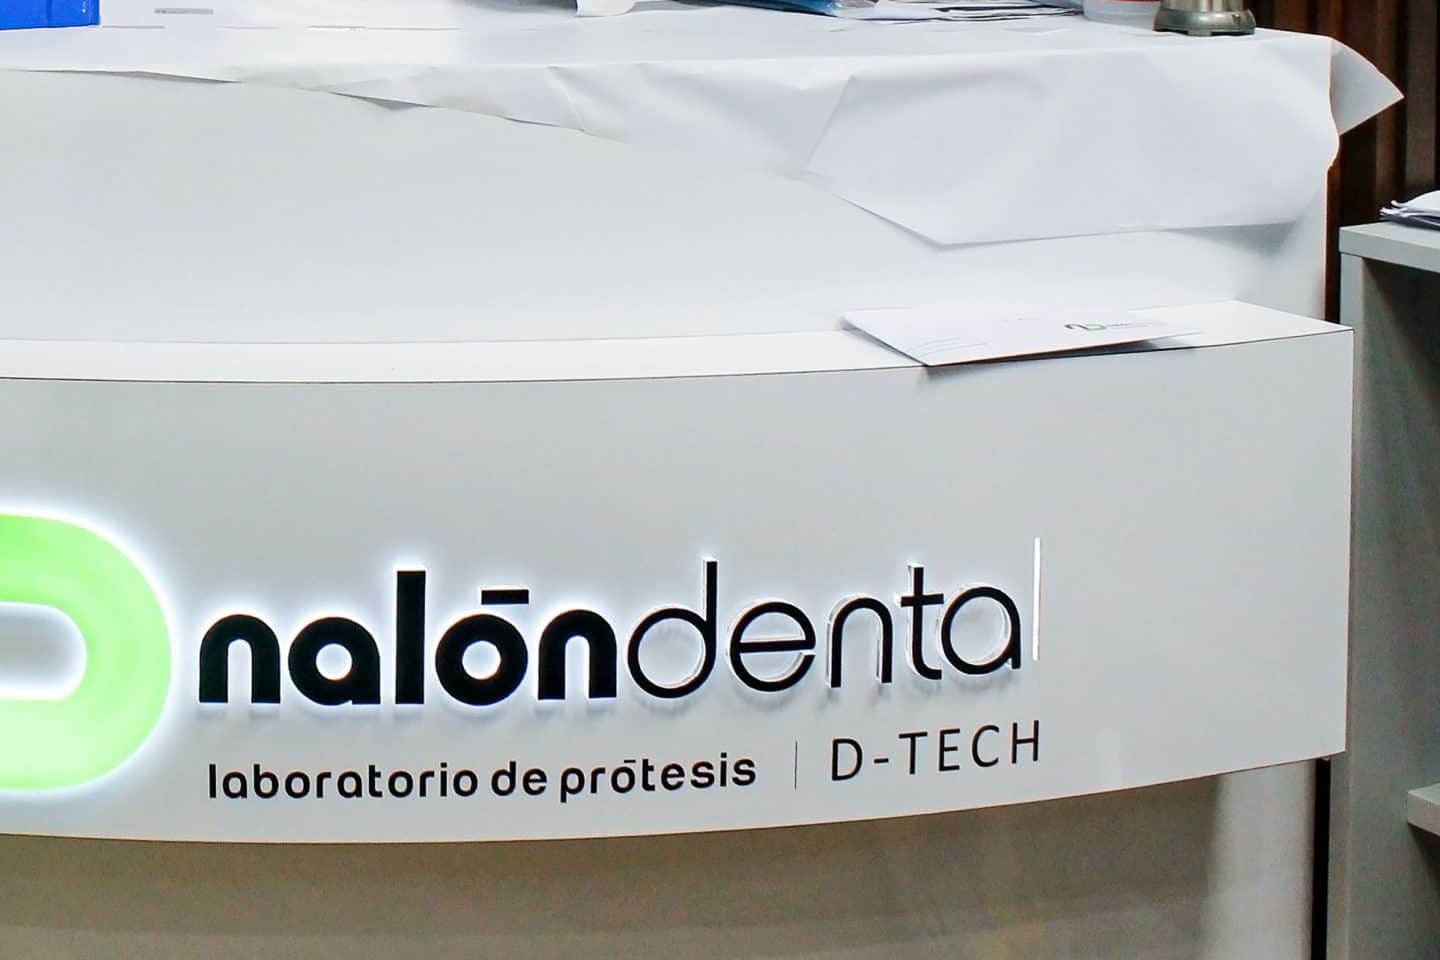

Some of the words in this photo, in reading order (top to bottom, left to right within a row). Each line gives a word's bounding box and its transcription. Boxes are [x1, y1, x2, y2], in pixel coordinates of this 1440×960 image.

[831, 719, 1040, 782] D-TECH
[208, 762, 478, 800] laboratorio
[491, 760, 548, 797] de
